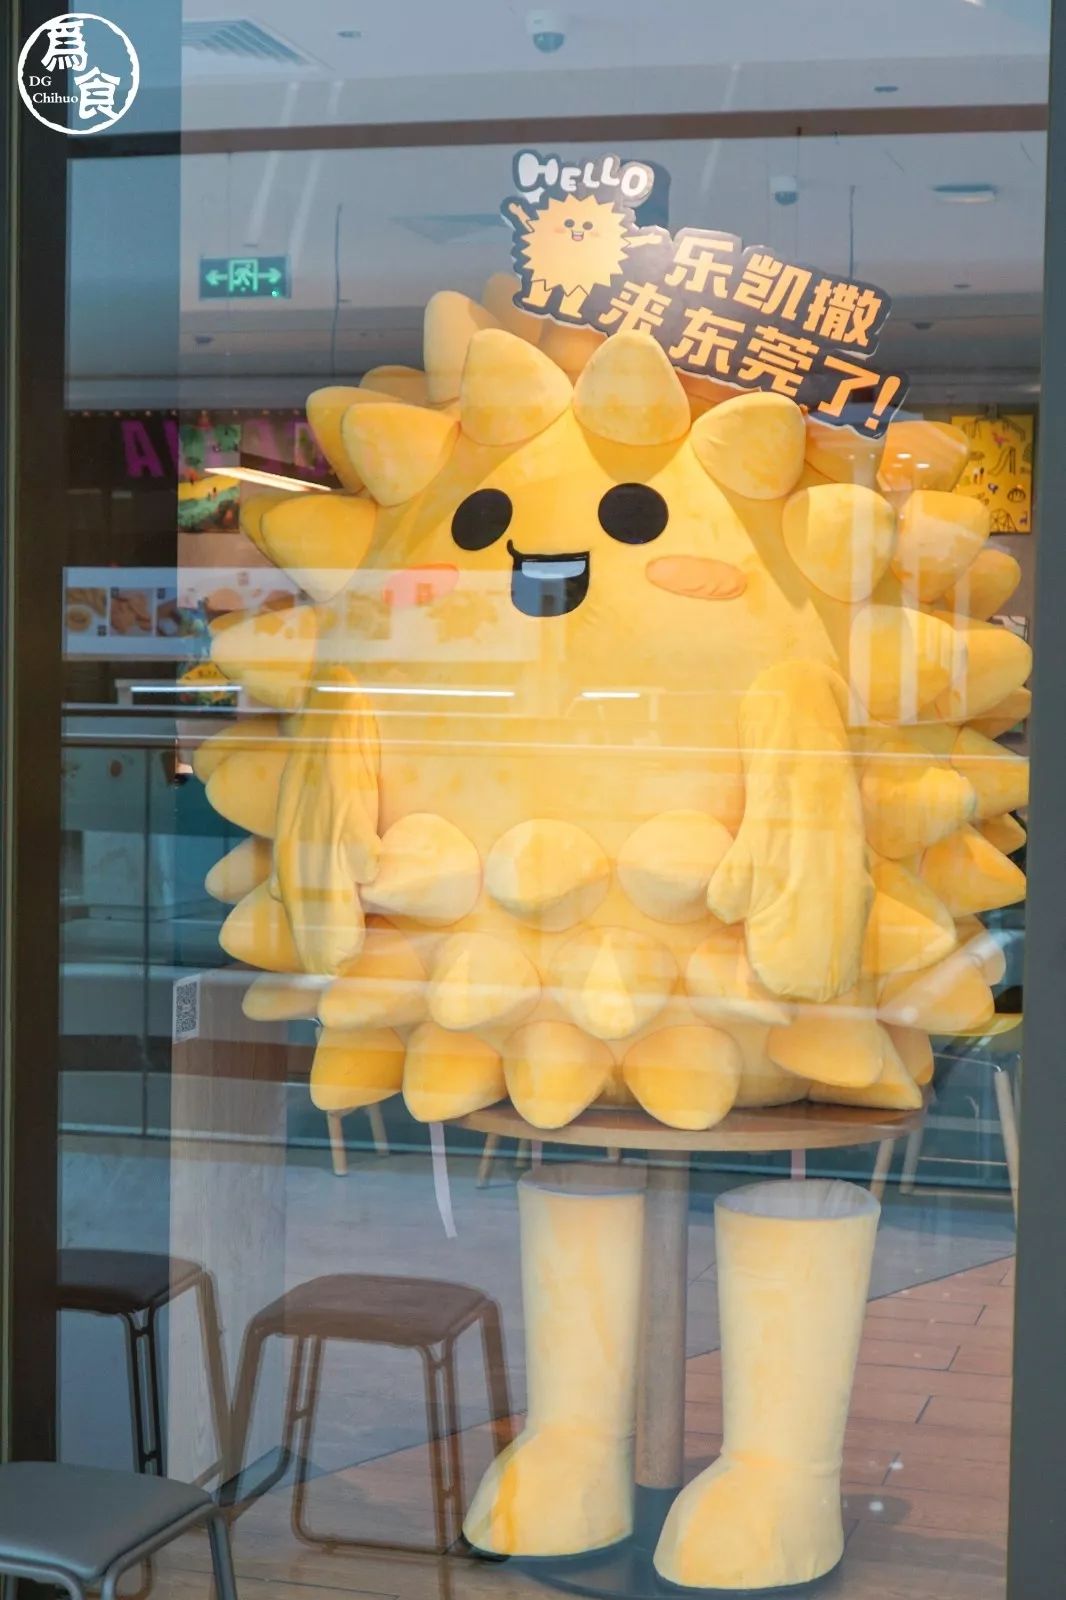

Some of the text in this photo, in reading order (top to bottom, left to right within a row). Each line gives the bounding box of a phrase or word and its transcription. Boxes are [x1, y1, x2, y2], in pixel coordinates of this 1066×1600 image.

[518, 153, 648, 197] HELLO
[664, 236, 882, 347] 乐凯撒
